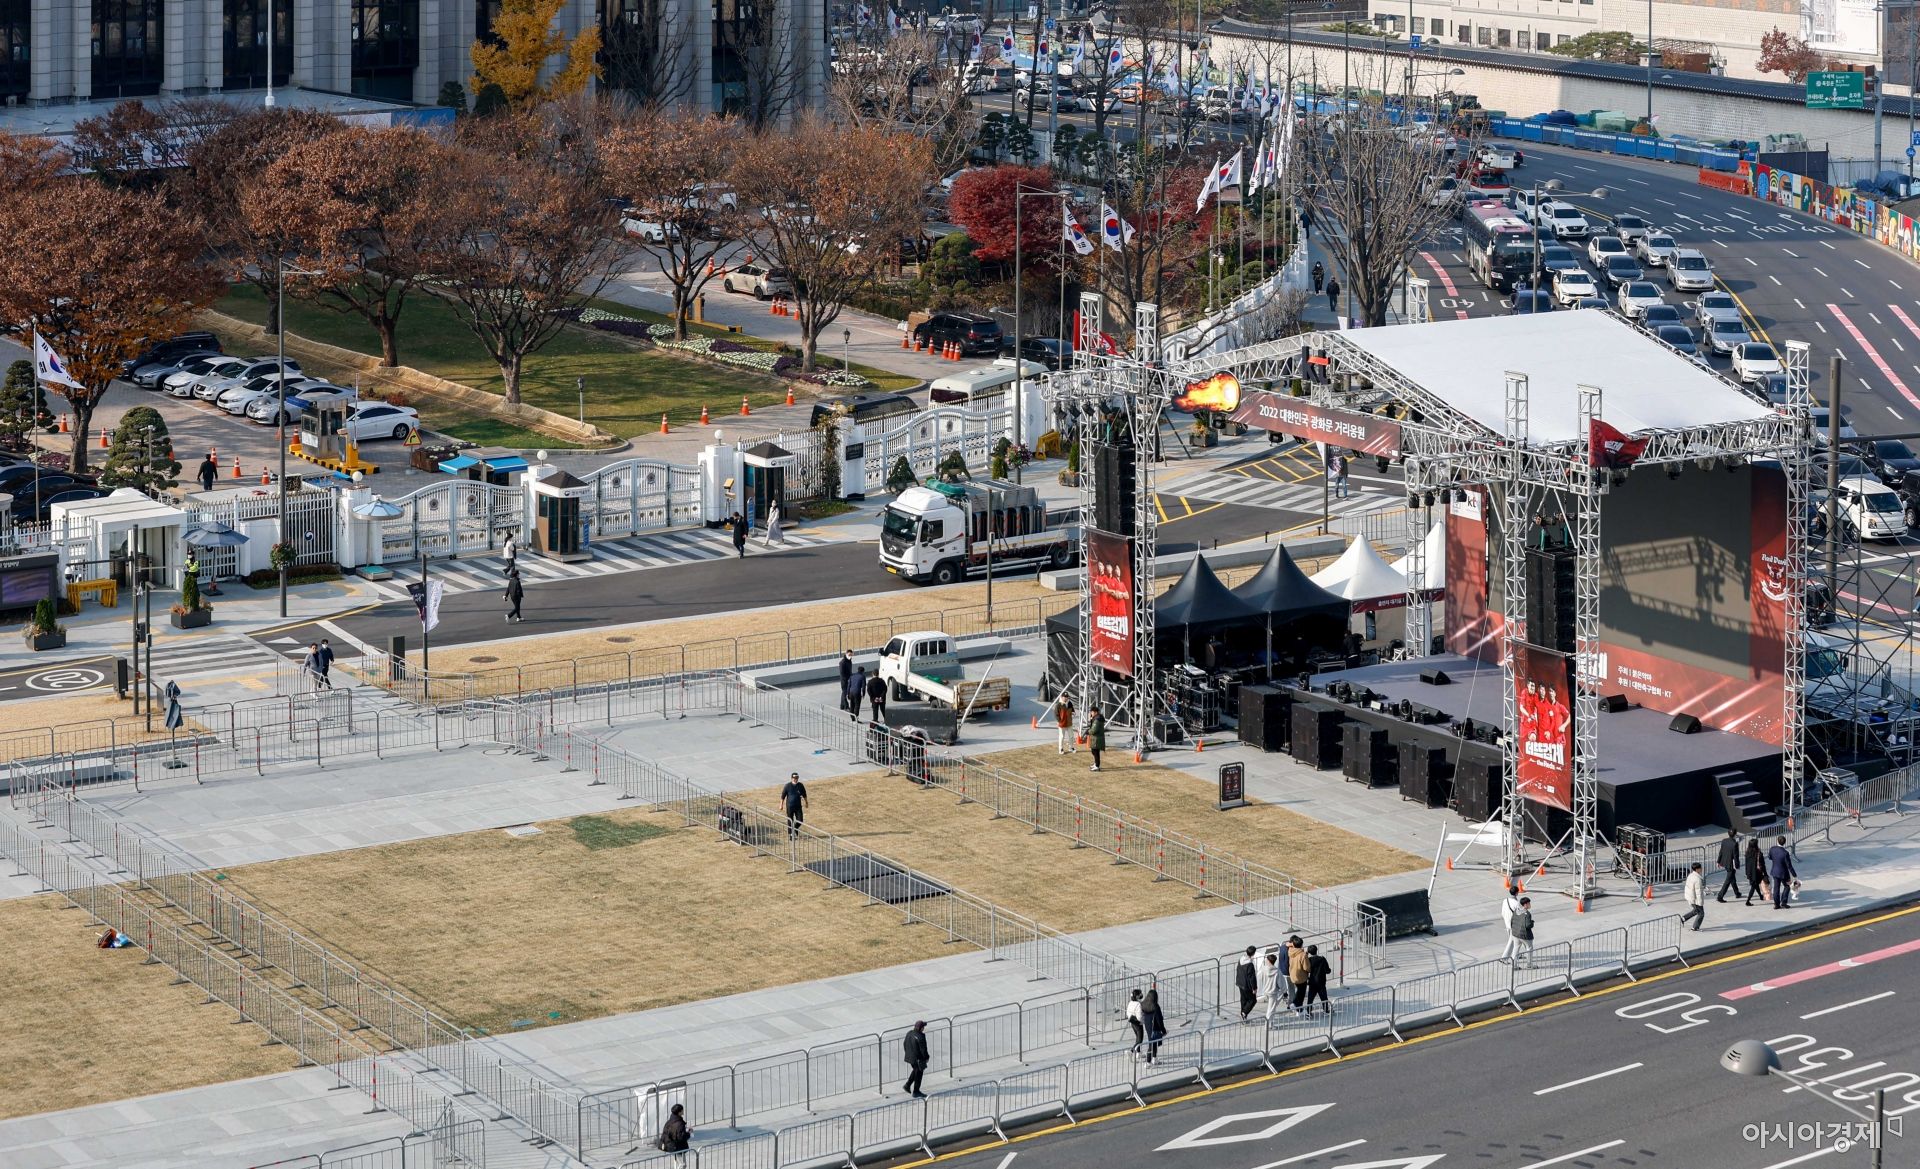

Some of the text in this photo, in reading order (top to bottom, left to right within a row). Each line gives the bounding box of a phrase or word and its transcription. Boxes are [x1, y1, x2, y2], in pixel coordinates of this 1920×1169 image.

[1259, 404, 1366, 441] 2022 대한민국 광화문 거리응원
[1467, 496, 1477, 508] kt
[42, 671, 93, 688] 20
[1617, 677, 1628, 688] 후원
[1632, 668, 1653, 682] 붉은악마
[1615, 992, 1738, 1034] 50
